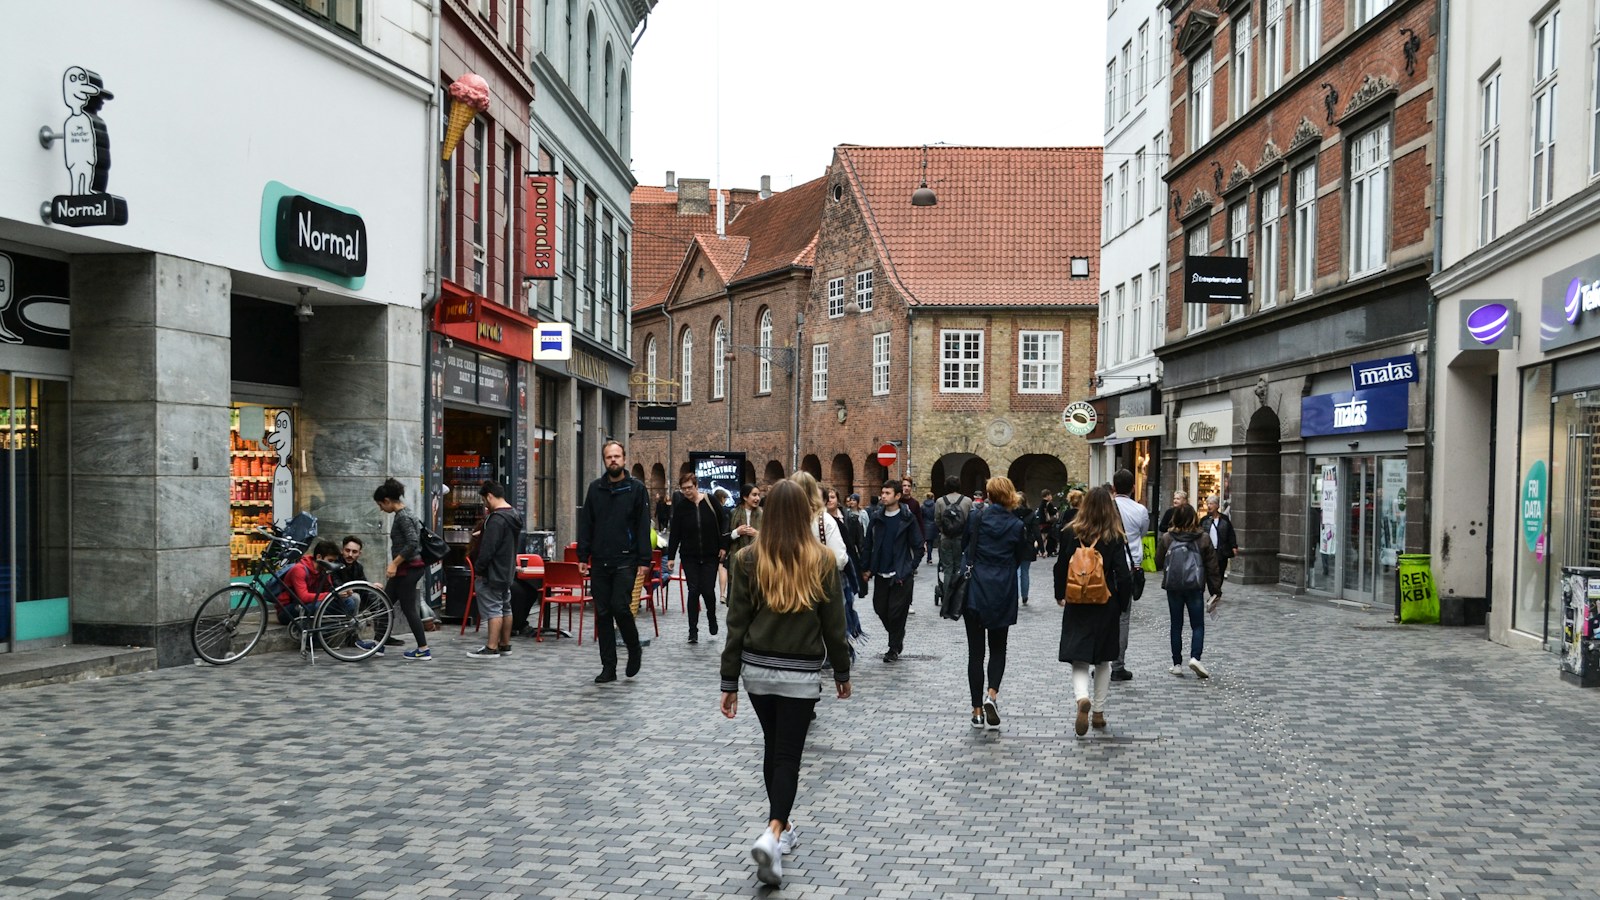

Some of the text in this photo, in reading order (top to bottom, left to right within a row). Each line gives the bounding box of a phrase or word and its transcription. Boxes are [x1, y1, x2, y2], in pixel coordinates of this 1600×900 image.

[58, 199, 107, 218] Normal
[531, 182, 552, 269] paradis
[298, 210, 359, 261] Normal
[1359, 362, 1413, 386] matas
[1067, 403, 1095, 417] ESPRESSO
[1333, 396, 1368, 428] matas
[1069, 424, 1093, 435] HOUSE
[1188, 421, 1217, 444] Glitter
[698, 465, 737, 478] McCARTNEY
[699, 461, 715, 470] PAUL
[1528, 480, 1538, 498] FRI
[1524, 500, 1542, 518] DATA
